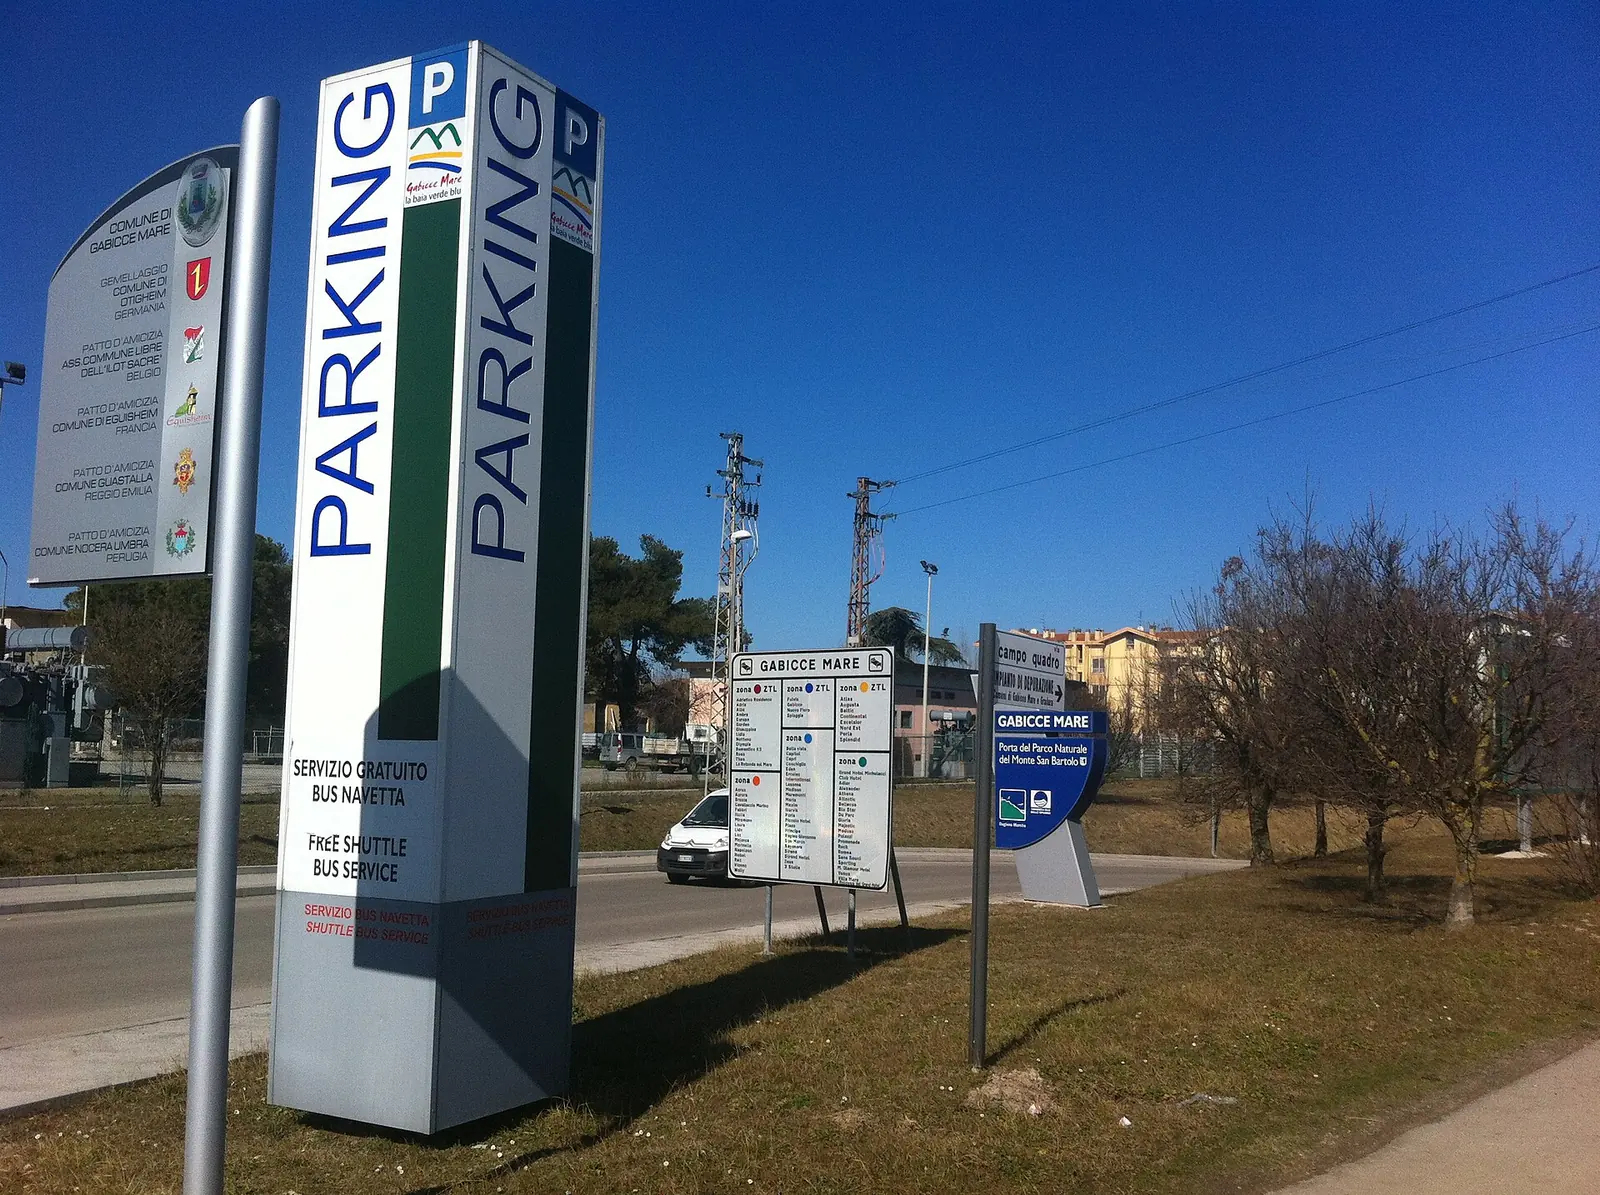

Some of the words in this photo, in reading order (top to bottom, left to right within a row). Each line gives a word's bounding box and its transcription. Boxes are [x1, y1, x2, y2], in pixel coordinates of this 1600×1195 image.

[422, 61, 454, 114] P
[564, 106, 588, 156] P
[412, 194, 427, 203] baia
[429, 190, 448, 200] verde
[450, 187, 461, 196] blu
[110, 211, 158, 234] COMUNE
[161, 208, 172, 220] DI
[90, 232, 136, 254] GABICCE
[138, 223, 171, 241] MARE
[100, 264, 168, 287] GEMELLAGGIO
[113, 279, 156, 296] COMUNE
[158, 276, 167, 286] DI
[120, 288, 166, 306] OTIGHEIM
[115, 302, 165, 320] GERMANIA
[310, 81, 396, 558] PARKING
[470, 77, 544, 563] PARKING
[82, 340, 112, 353] PATTO
[136, 342, 162, 355] LIBRE
[127, 367, 161, 381] BELGIO
[78, 404, 107, 416] PATTO
[52, 418, 94, 433] COMUNE
[95, 416, 104, 427] DI
[106, 408, 158, 425] EGUISHEIM
[116, 422, 157, 435] FRANCIA
[73, 466, 103, 477] PATTO
[55, 479, 97, 492] COMUNE
[98, 472, 153, 487] GUASTALLA
[85, 489, 120, 501] REGGIO
[122, 486, 152, 497] EMILIA
[68, 530, 98, 541] PATTO
[35, 545, 73, 557] COMUNE
[75, 542, 112, 554] NOCERA
[114, 539, 149, 551] UMBRA
[106, 552, 148, 563] PERUGIA
[760, 659, 816, 672] GABICCE
[823, 658, 860, 670] MARE
[998, 646, 1026, 664] campo
[1032, 652, 1060, 669] quadro
[998, 715, 1051, 728] GABICCE
[1054, 716, 1089, 728] MARE
[999, 742, 1018, 752] Porta
[1020, 743, 1030, 752] del
[1032, 744, 1053, 753] Parco
[1055, 744, 1087, 754] Naturale
[293, 759, 352, 779] SERVIZIO
[356, 761, 428, 781] GRATUITO
[999, 755, 1010, 764] del
[1011, 755, 1035, 765] Monte
[1037, 756, 1050, 765] San
[1051, 757, 1078, 766] Bartolo
[312, 785, 338, 803] BUS
[342, 786, 405, 807] NAVETTA
[308, 834, 340, 852] FREE
[343, 835, 407, 857] SHUTTLE
[314, 859, 339, 878] BUS
[343, 861, 398, 883] SERVICE
[304, 903, 352, 919] SERVIZIO
[355, 908, 377, 922] BUS
[380, 912, 430, 927] NAVETTA
[306, 921, 353, 937] SHUTTLE
[356, 926, 378, 940] BUS
[381, 930, 429, 945] SERVICE
